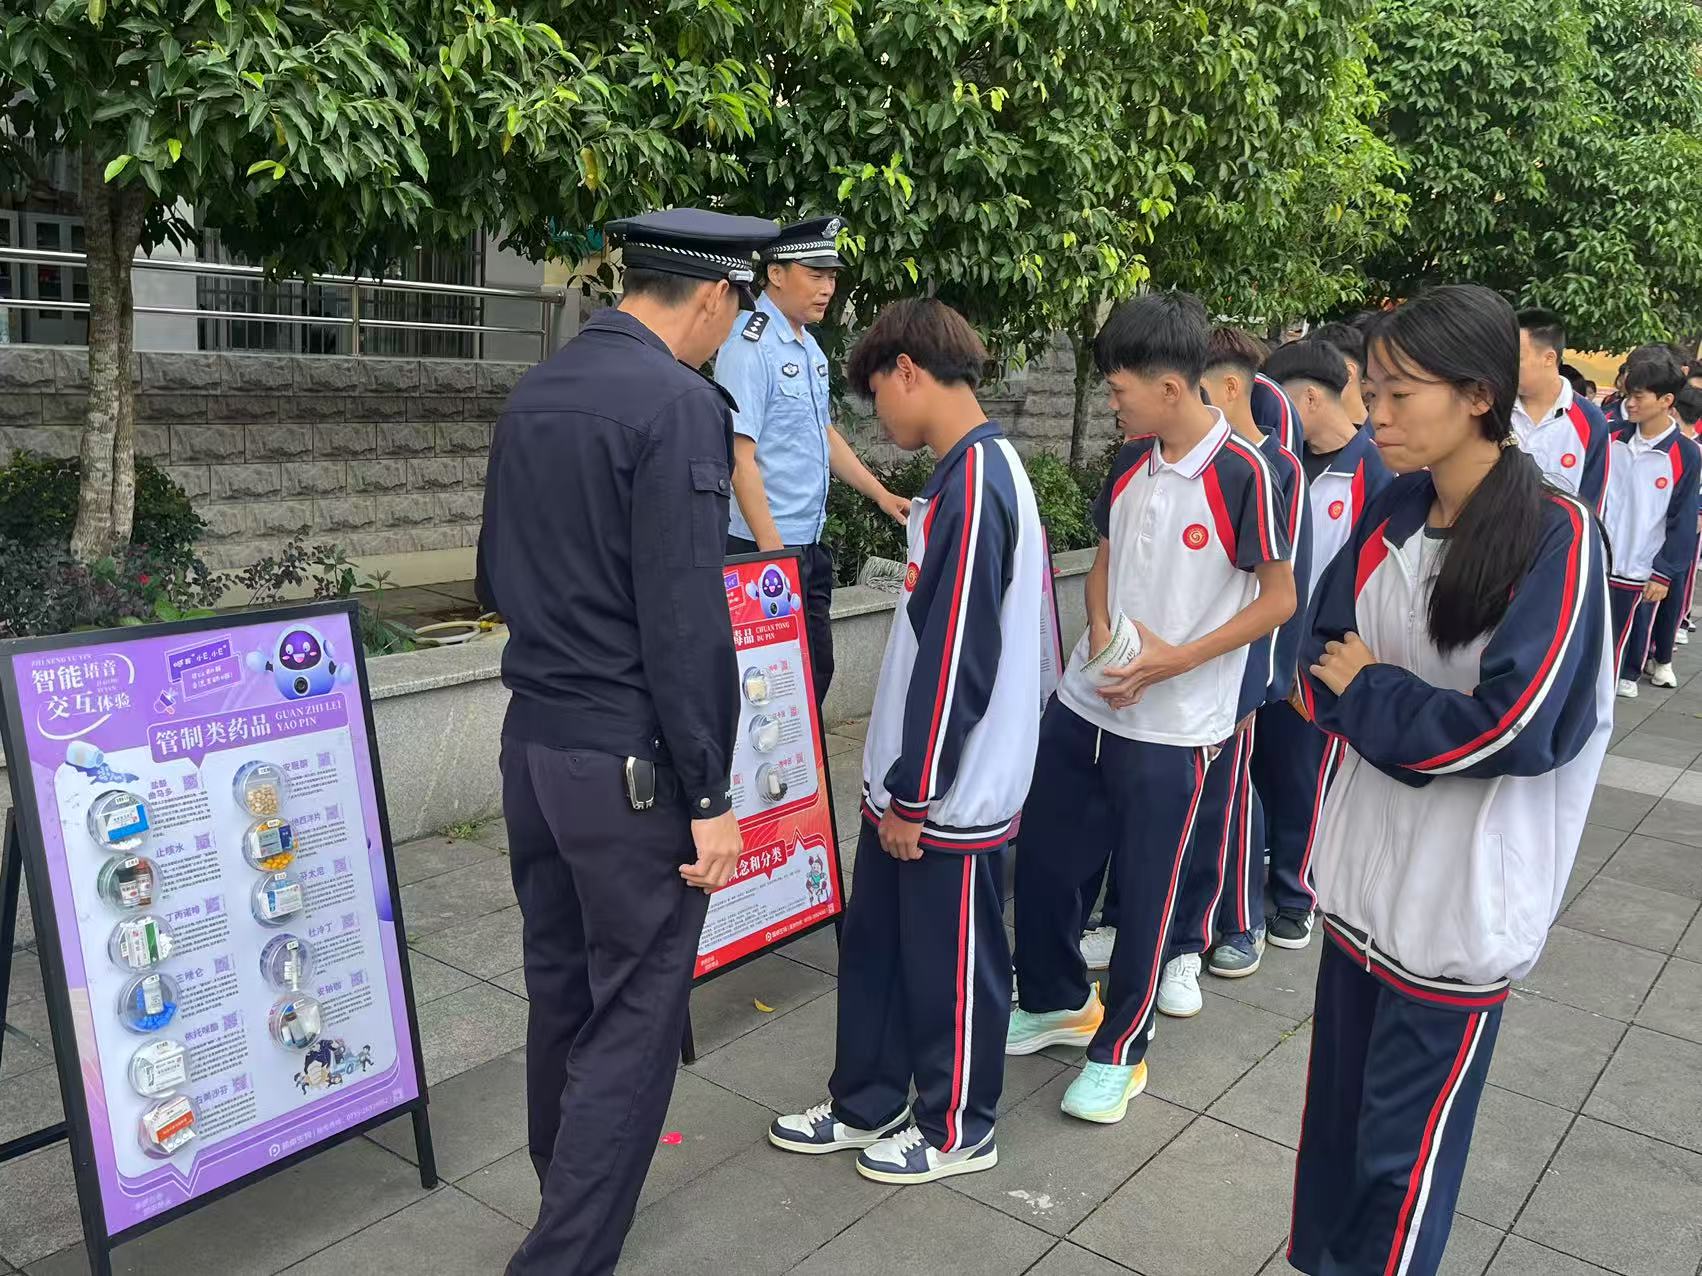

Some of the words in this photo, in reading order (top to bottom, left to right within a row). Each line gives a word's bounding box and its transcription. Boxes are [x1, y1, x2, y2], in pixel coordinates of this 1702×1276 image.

[32, 660, 116, 694] 智能语音
[44, 692, 131, 720] 交互体验
[275, 707, 303, 720] GUAN
[305, 703, 325, 715] ZHI
[326, 700, 342, 711] LEI
[156, 714, 271, 755] 管制类药品
[277, 720, 297, 732] YAO
[299, 717, 317, 729] PIN
[156, 842, 184, 858] 止咳水
